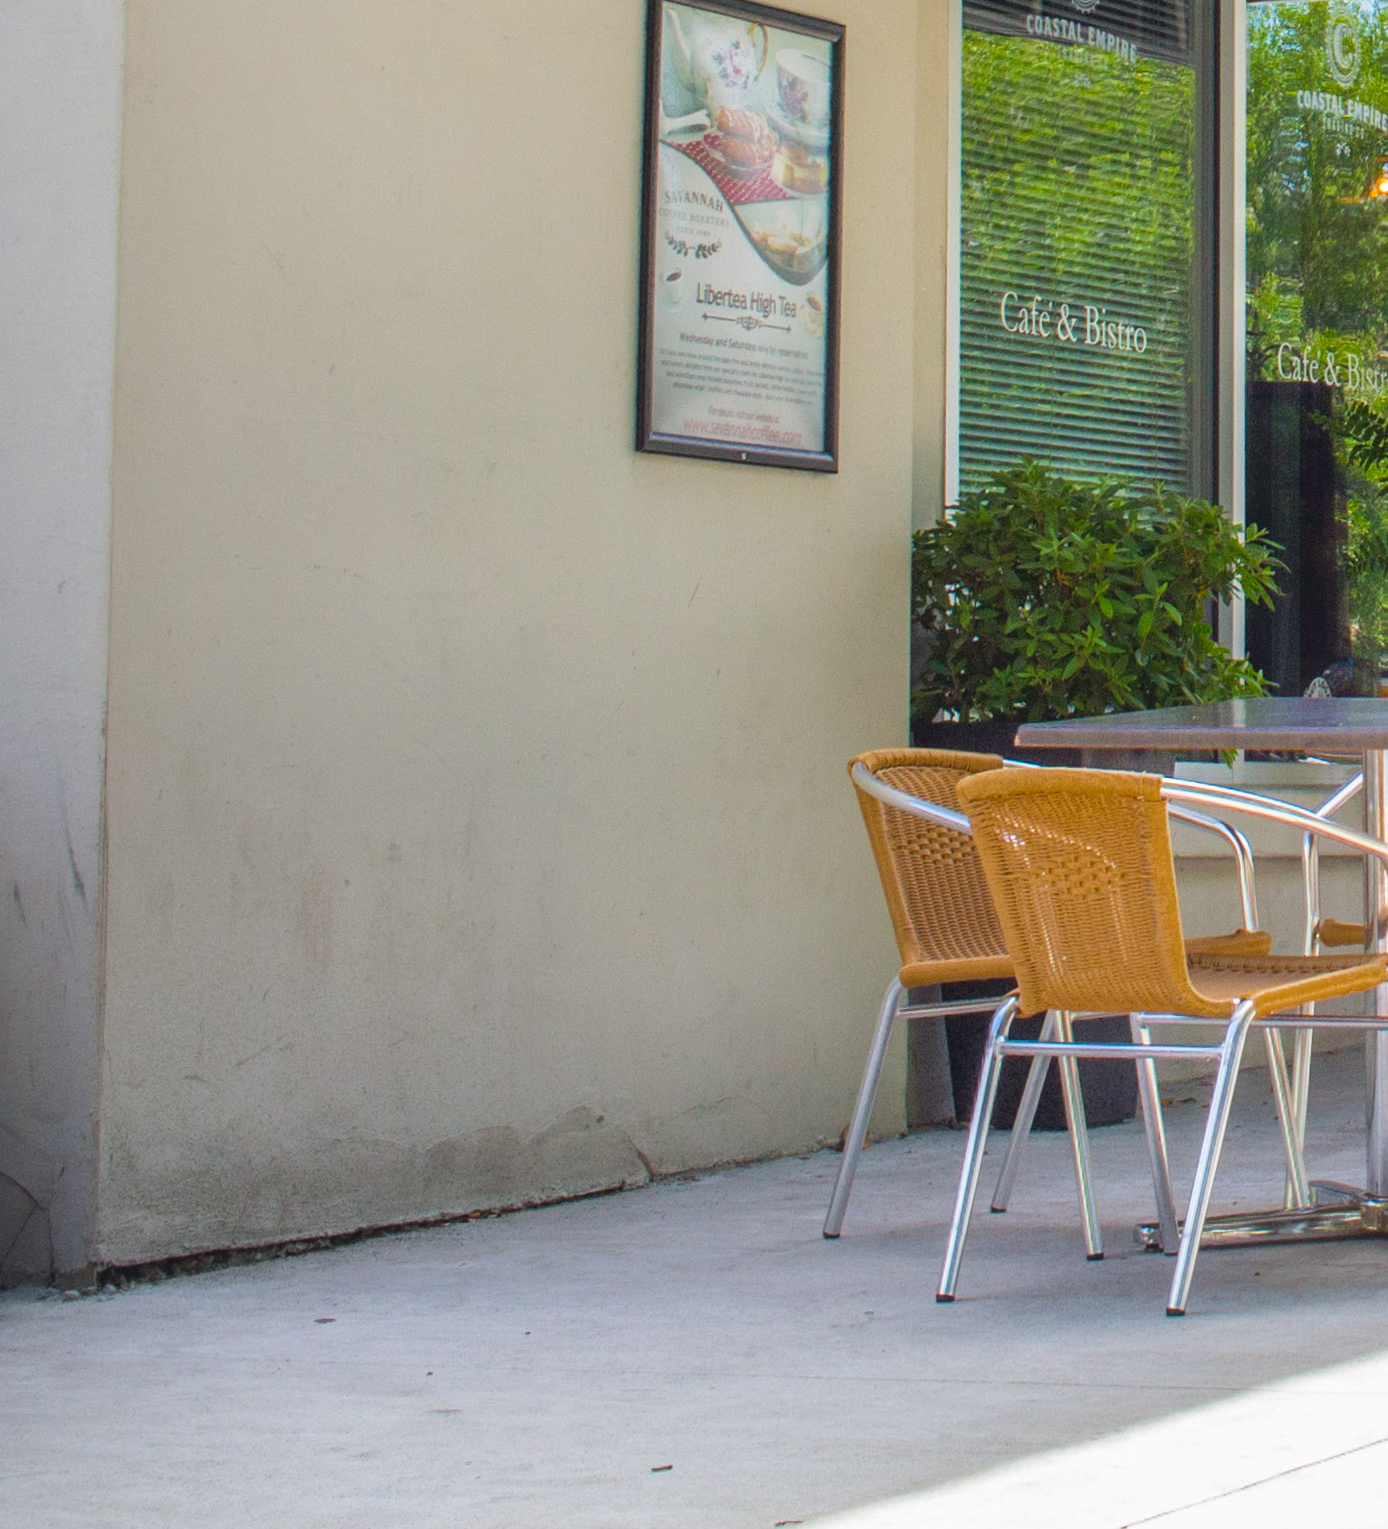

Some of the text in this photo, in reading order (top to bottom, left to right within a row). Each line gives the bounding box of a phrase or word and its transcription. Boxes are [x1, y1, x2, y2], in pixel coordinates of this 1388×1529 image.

[1026, 14, 1085, 43] COASTAL
[1088, 26, 1138, 64] EMPIRE
[1297, 89, 1388, 133] COASTAL EMPIRE
[664, 190, 724, 213] SAVANNAH
[696, 282, 797, 318] Libertea High Tea
[1001, 291, 1147, 353] Café & Bistro
[1324, 352, 1342, 387] &
